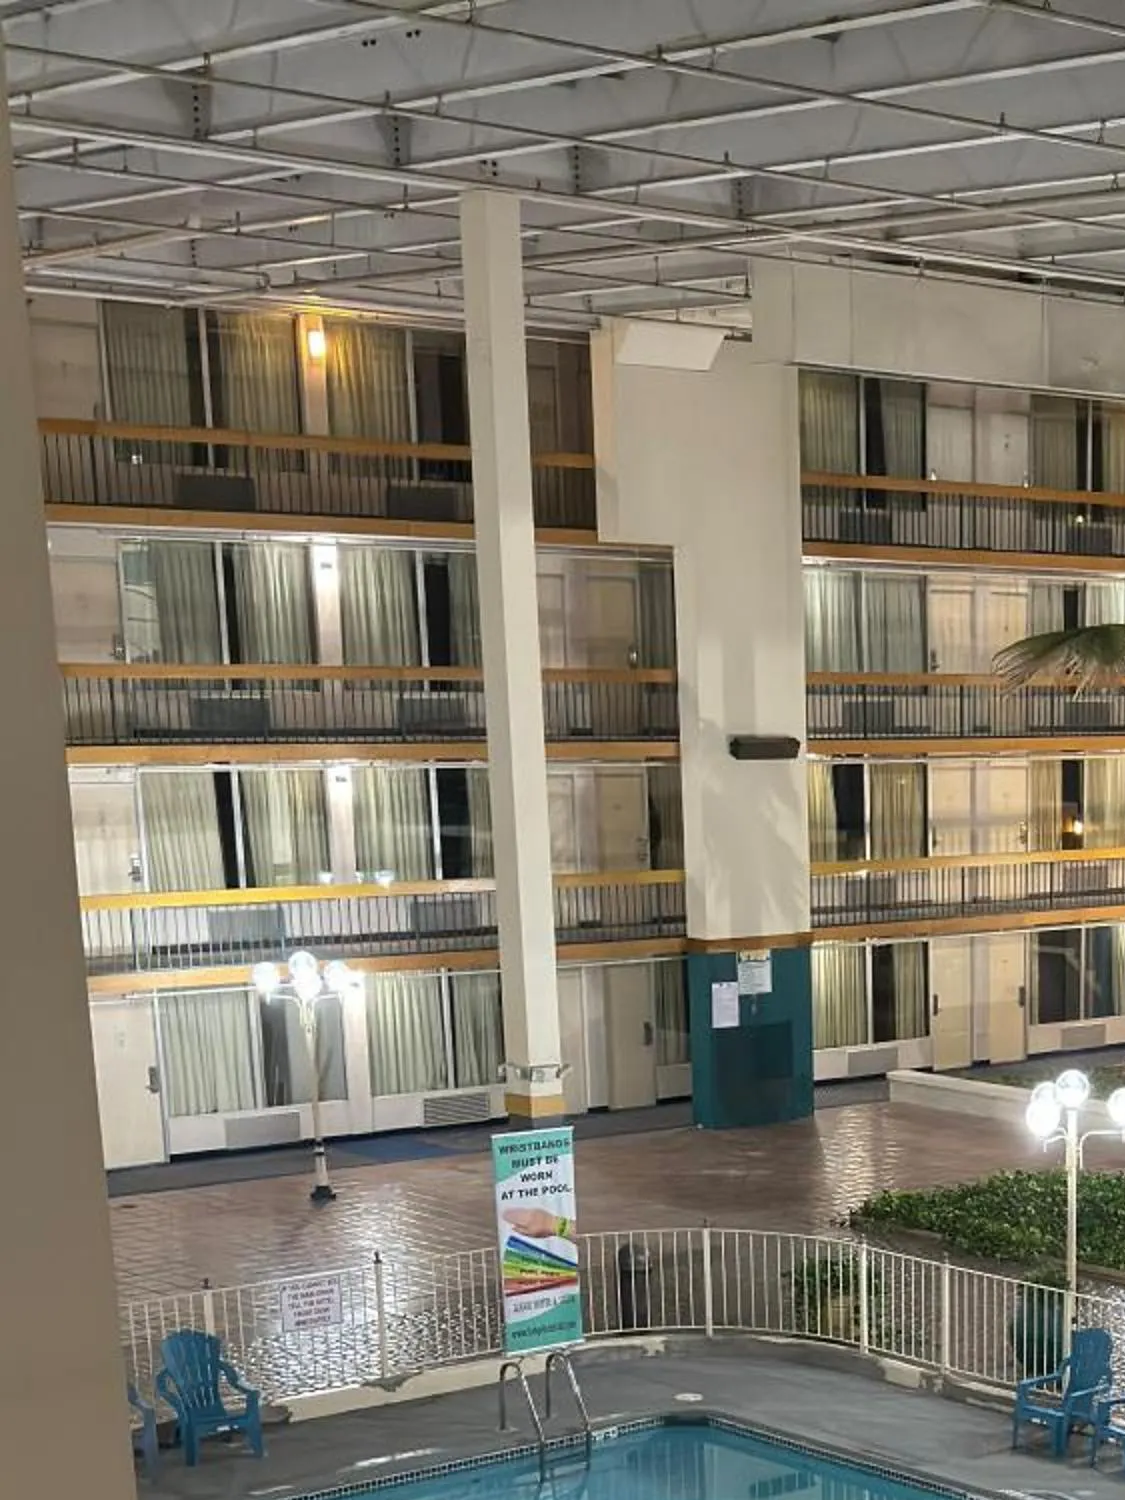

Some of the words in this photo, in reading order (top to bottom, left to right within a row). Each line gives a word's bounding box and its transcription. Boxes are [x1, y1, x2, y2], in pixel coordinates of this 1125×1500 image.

[498, 1137, 570, 1154] WRISTBANDS
[511, 1156, 542, 1168] MUST
[545, 1155, 559, 1165] BE
[520, 1171, 553, 1183] WORN
[501, 1189, 515, 1201] AT
[517, 1188, 538, 1199] THE
